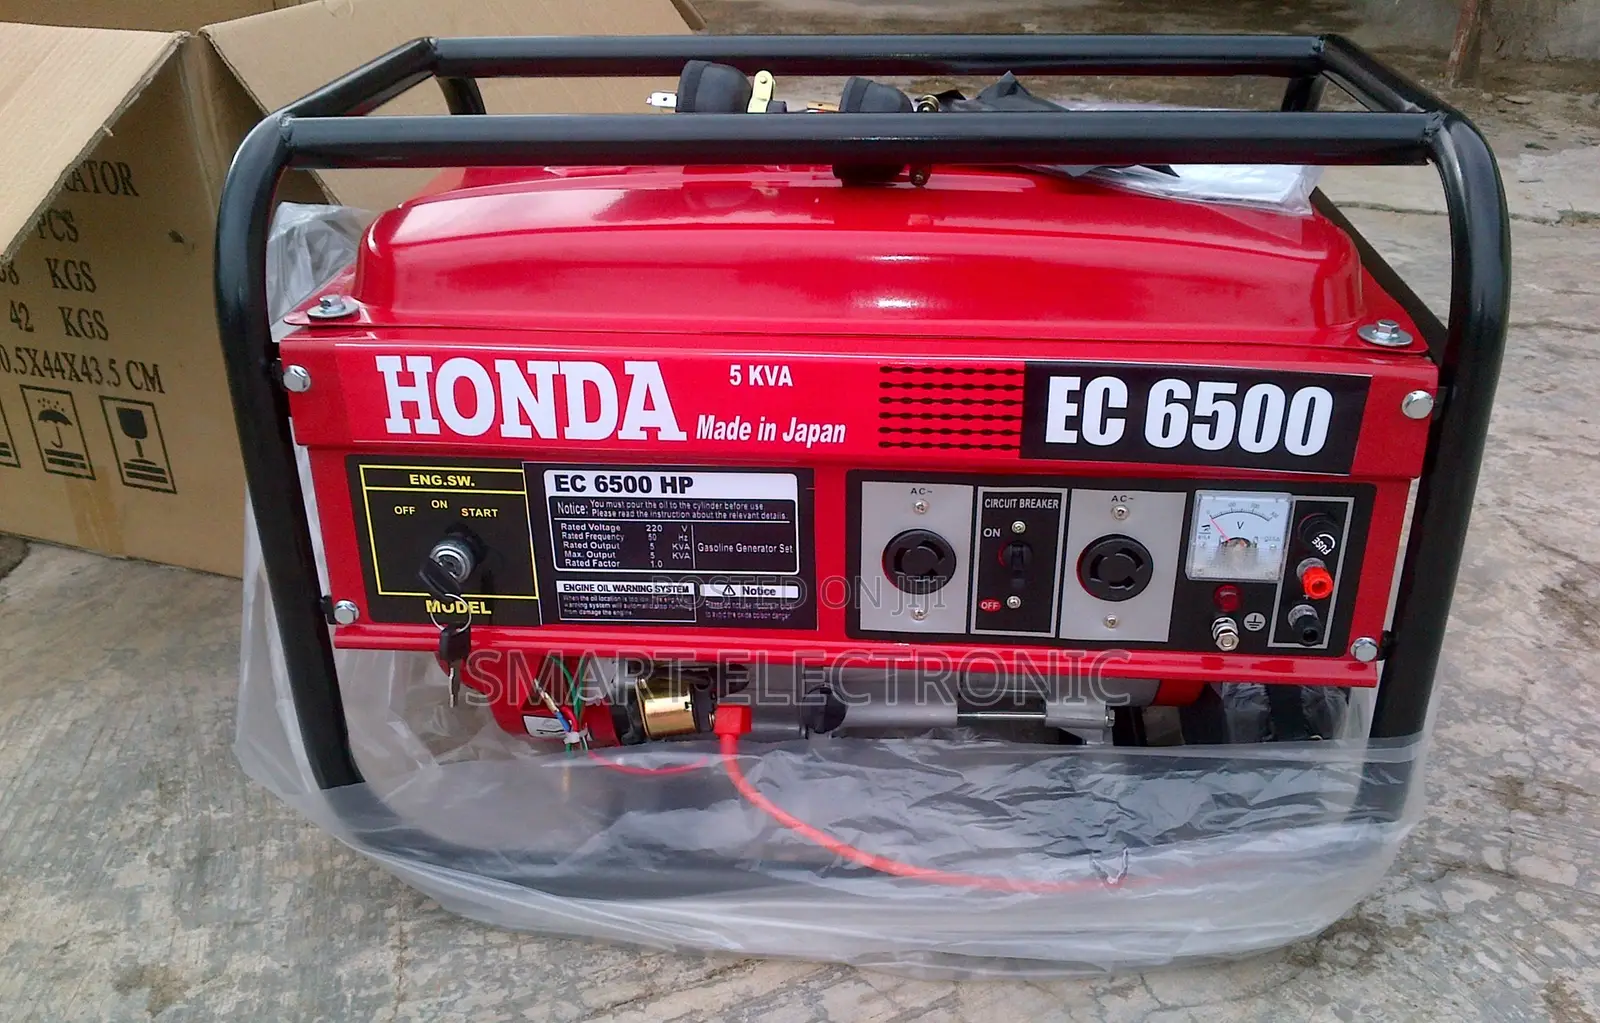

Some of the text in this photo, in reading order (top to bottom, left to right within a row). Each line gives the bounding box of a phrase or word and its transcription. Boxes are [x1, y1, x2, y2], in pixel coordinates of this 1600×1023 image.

[64, 160, 139, 196] ATOR
[45, 258, 97, 293] KGS
[10, 300, 109, 341] 42 KGS
[126, 360, 165, 394] CM
[729, 364, 794, 386] 5 KVA
[375, 355, 687, 442] HONDA
[1045, 376, 1334, 457] EC 6500
[696, 414, 846, 448] Made in Japan
[409, 474, 475, 487] ENG.SW.
[554, 474, 694, 494] EC 6500 HP
[394, 500, 498, 517] OFF ON START
[557, 501, 589, 515] Notice:
[590, 500, 604, 508] You
[606, 500, 625, 508] must
[626, 502, 643, 510] pour
[645, 500, 657, 508] the
[679, 501, 691, 509] the
[692, 501, 722, 511] cylinder
[724, 502, 748, 510] before
[984, 498, 1059, 510] CIRCUIT BREAKER
[591, 508, 616, 517] Please
[618, 509, 635, 517] read
[636, 509, 648, 517] the
[650, 509, 690, 519] instruction
[692, 511, 714, 519] about
[715, 511, 727, 519] the
[728, 511, 759, 519] relevant
[561, 523, 586, 531] Rated
[588, 523, 621, 533] Voltage
[646, 524, 663, 532] 220
[1237, 521, 1244, 530] V
[562, 532, 584, 540] Rated
[585, 532, 625, 541] Frequency
[983, 528, 1000, 538] ON
[563, 541, 588, 549] Rated
[590, 541, 620, 550] Output
[697, 543, 793, 553] Gasoline Generator Set
[1312, 536, 1332, 555] FUSE
[564, 550, 584, 558] Max.
[586, 551, 616, 559] Output
[565, 559, 663, 568] Rated Factor 1.0
[564, 584, 689, 593] ENGINE OIL WARNING SYSTEM
[742, 586, 776, 596] Notice
[425, 599, 492, 614] MODEL
[981, 601, 999, 610] OFF
